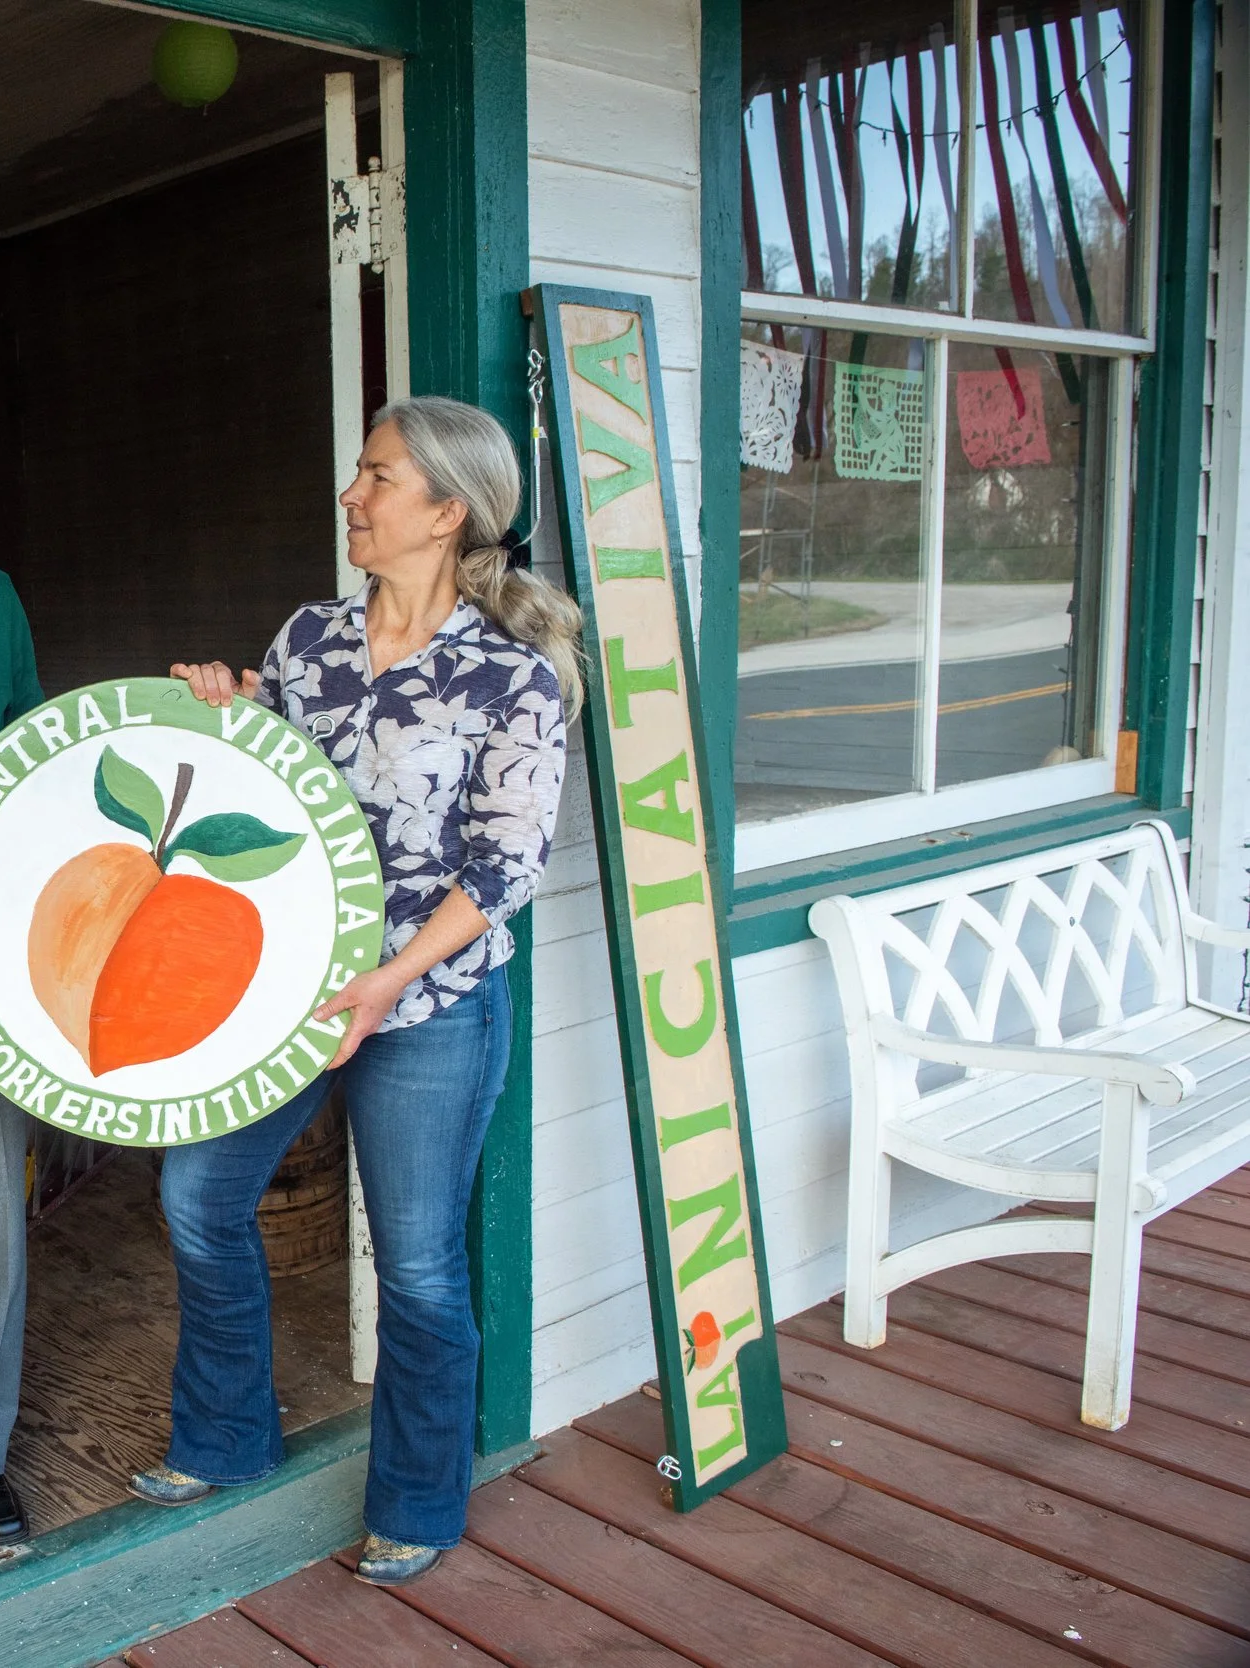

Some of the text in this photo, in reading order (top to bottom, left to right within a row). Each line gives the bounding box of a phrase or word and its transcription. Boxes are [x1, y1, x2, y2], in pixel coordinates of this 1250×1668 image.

[221, 706, 379, 935] VIRGINIA
[572, 318, 756, 1472] LA INICIATIVA
